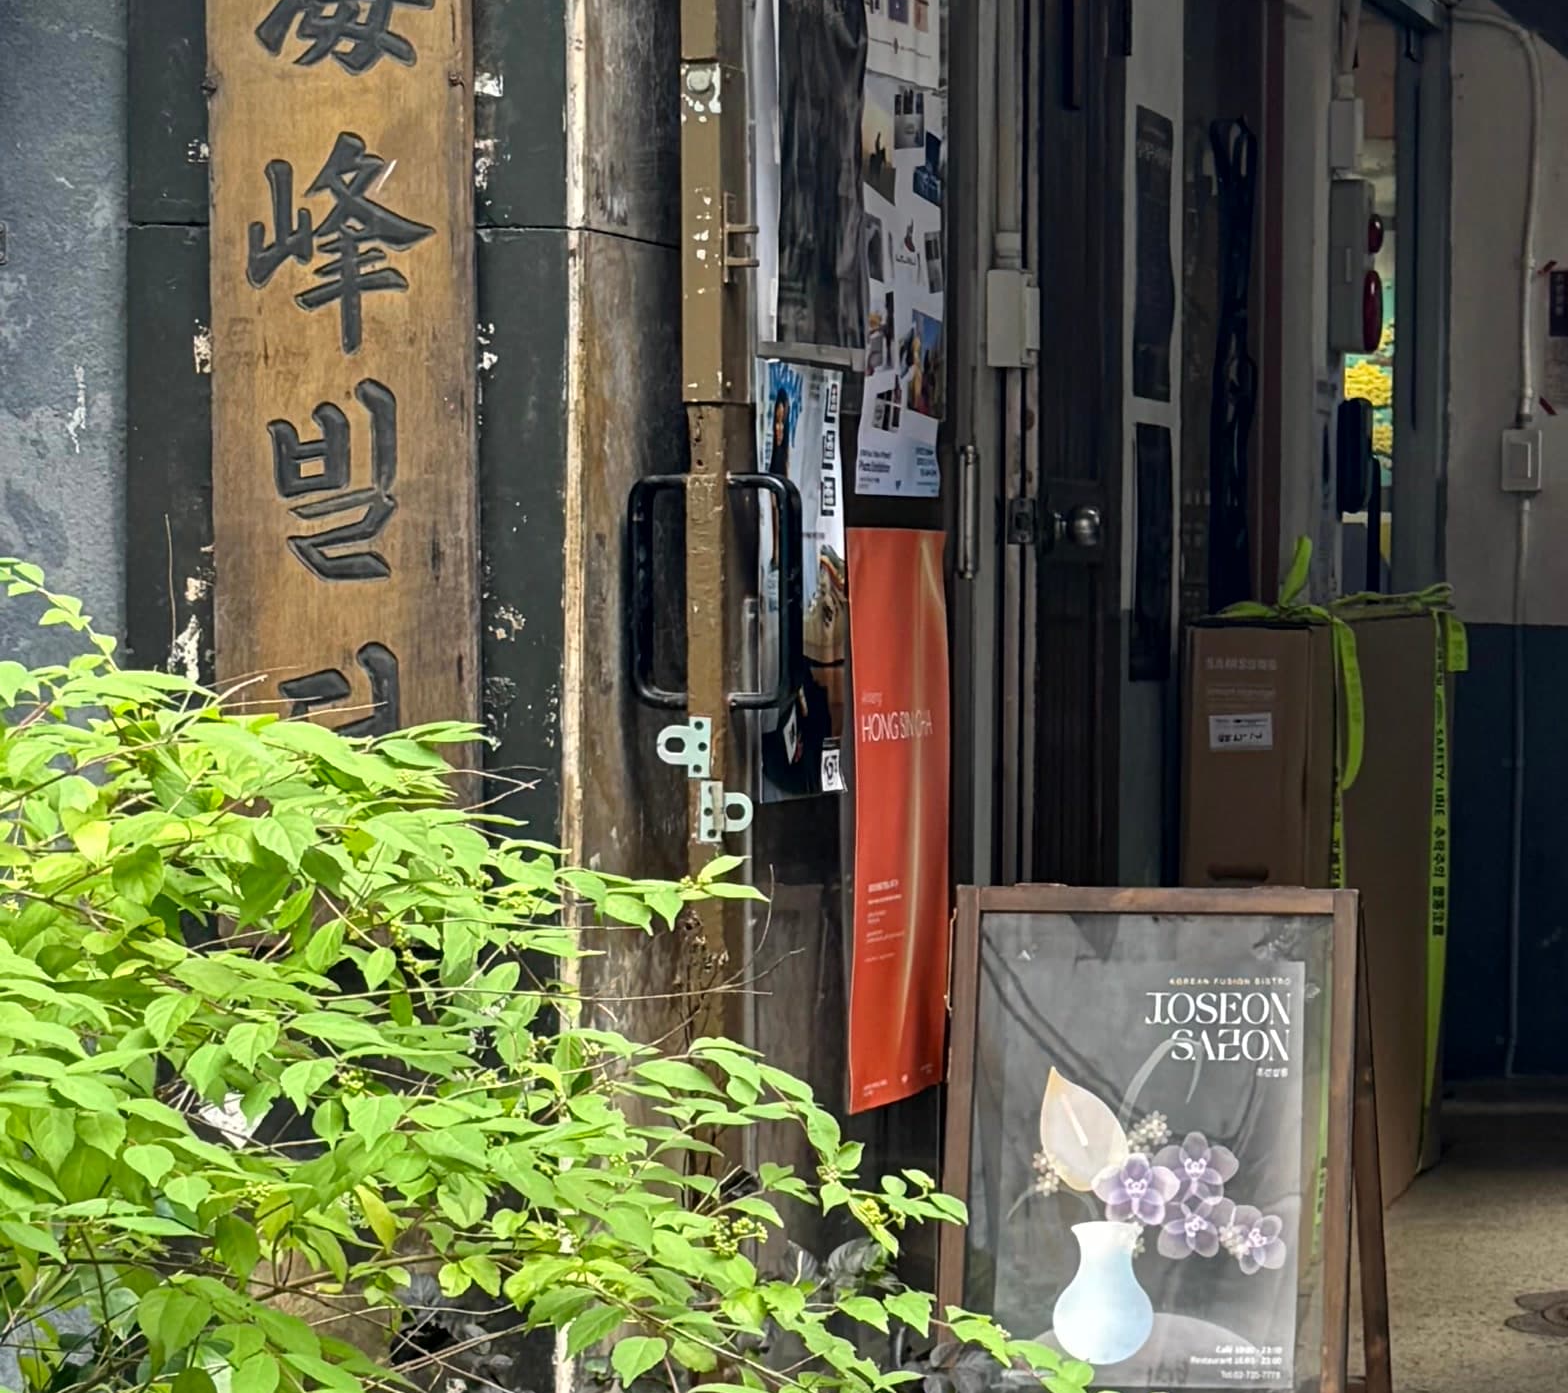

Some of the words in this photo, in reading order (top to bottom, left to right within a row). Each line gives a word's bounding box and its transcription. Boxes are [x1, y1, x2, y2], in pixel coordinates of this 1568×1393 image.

[862, 711, 899, 742] HONG
[1434, 728, 1445, 780] SAFETY
[1168, 977, 1210, 986] KOREAN
[1213, 977, 1250, 986] FUSION
[1254, 977, 1292, 986] BISTRO
[1144, 991, 1292, 1025] JOSEON
